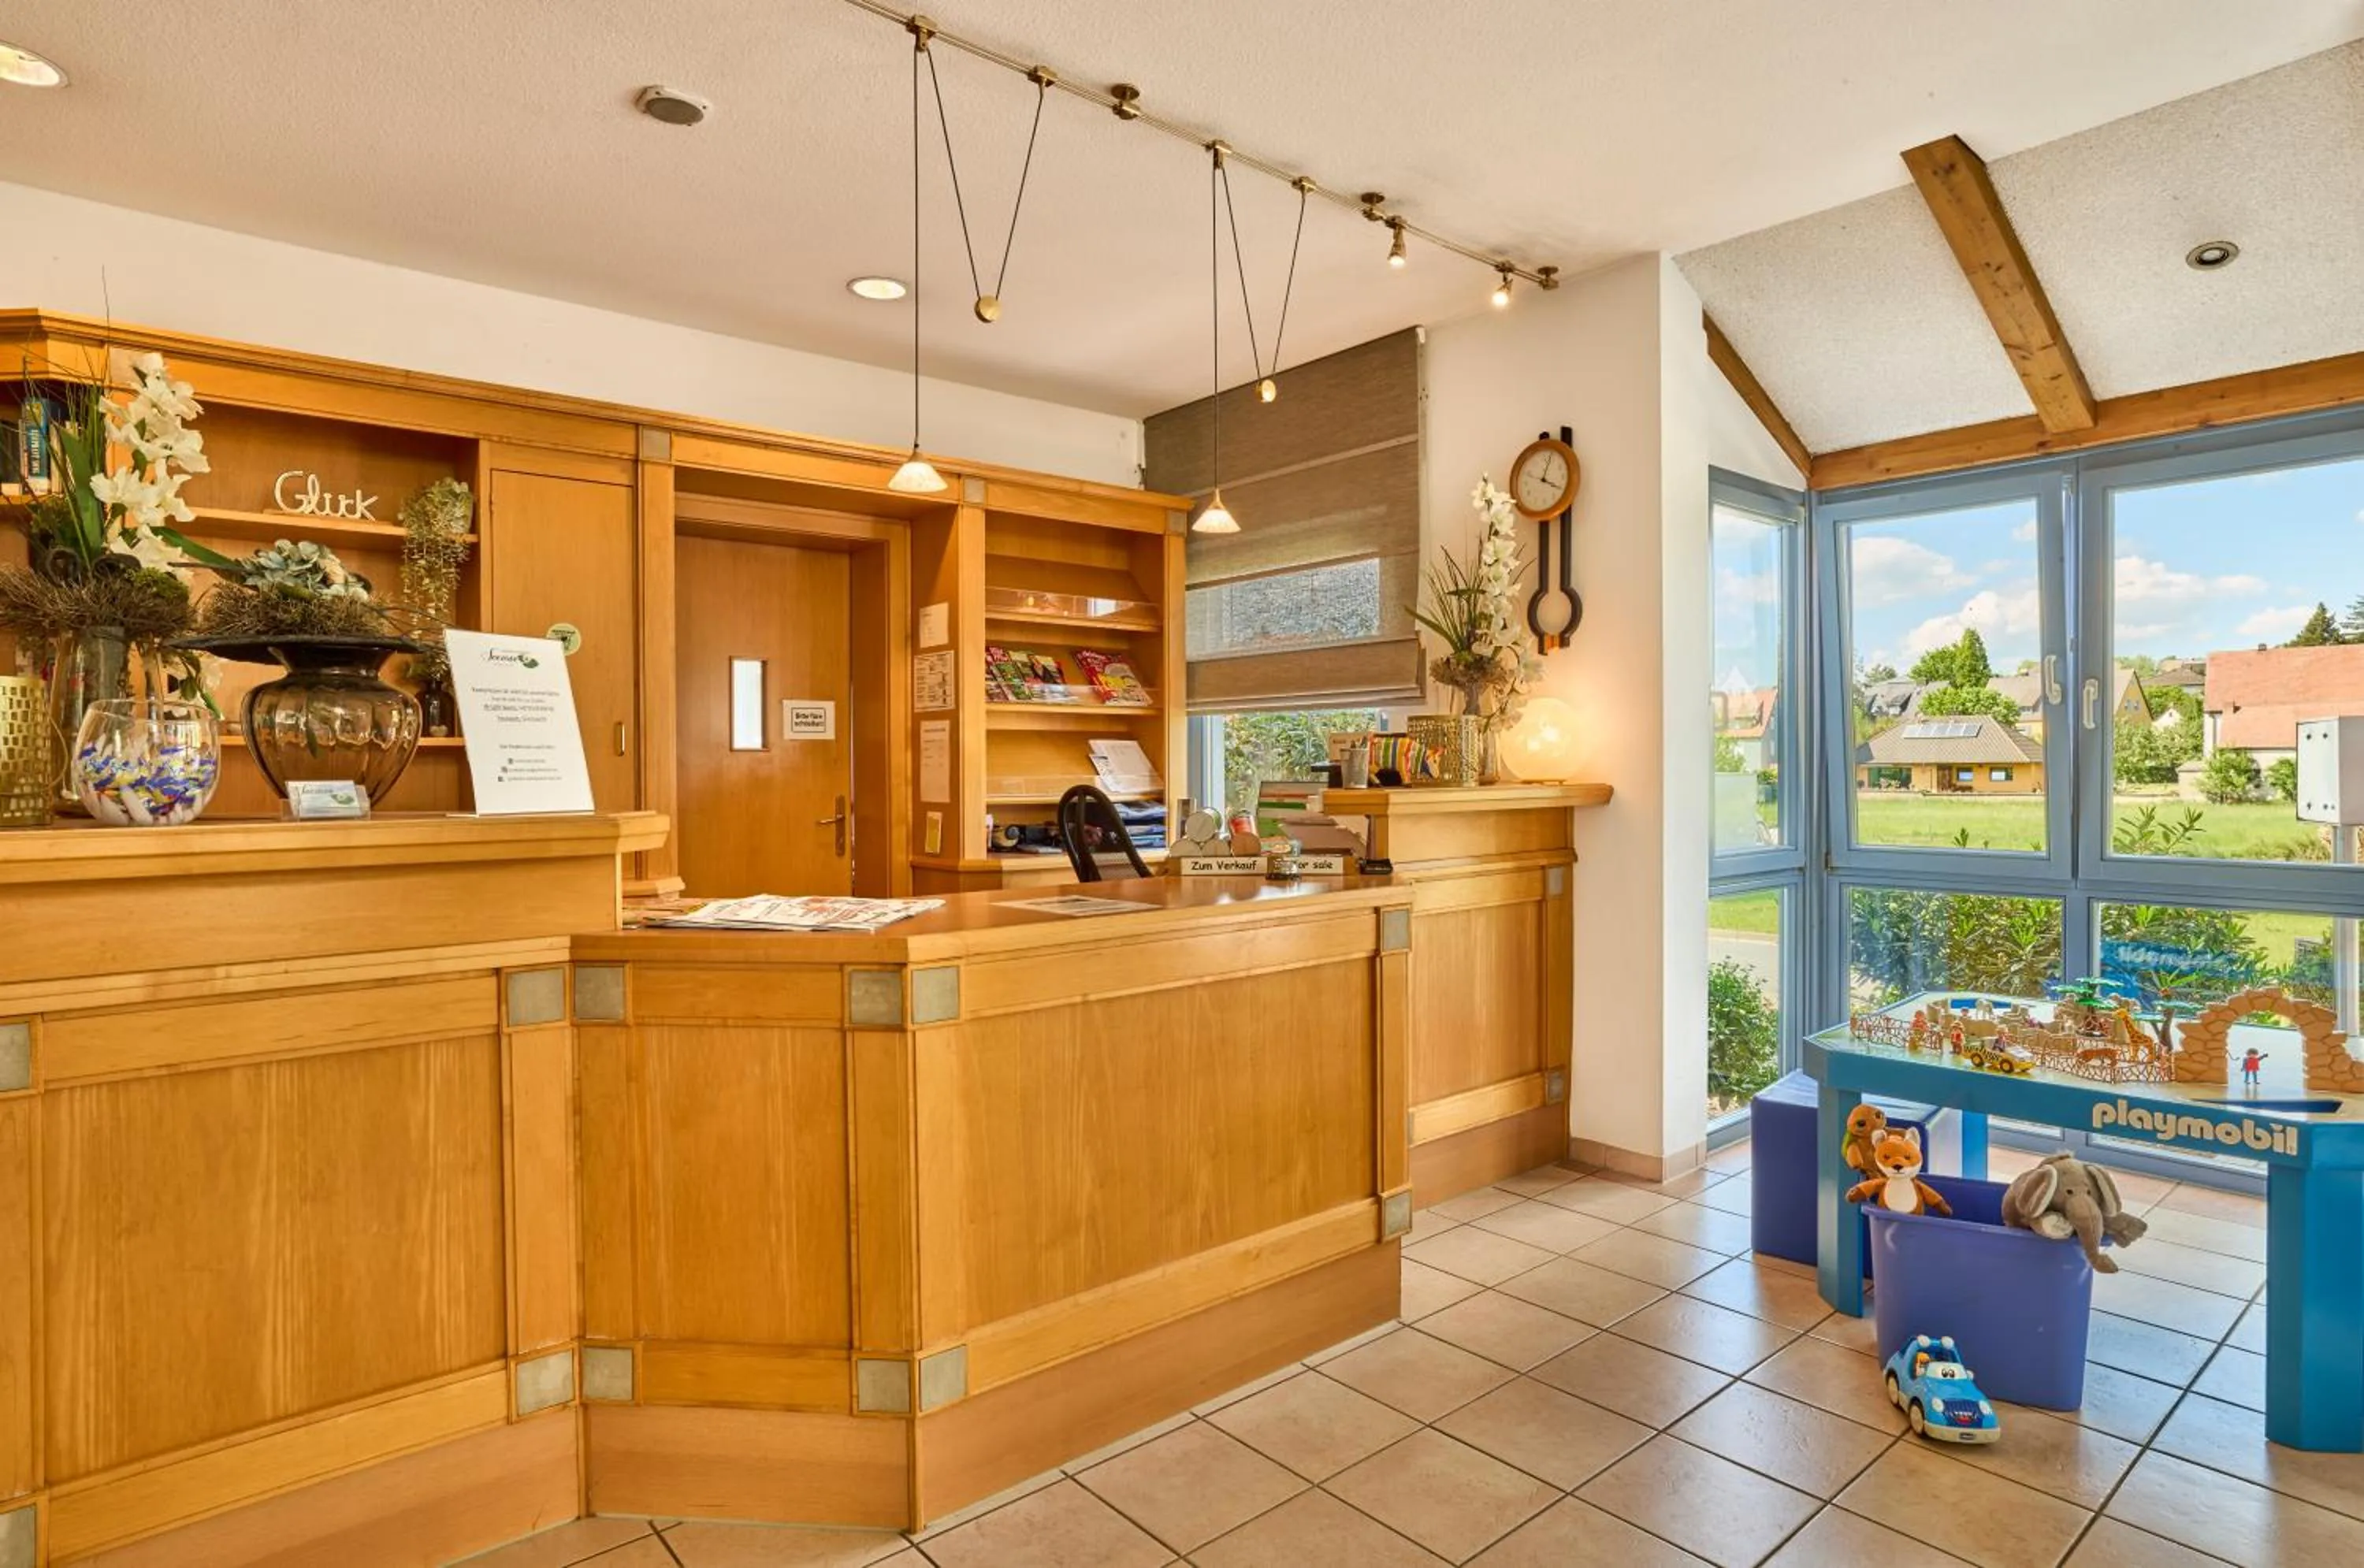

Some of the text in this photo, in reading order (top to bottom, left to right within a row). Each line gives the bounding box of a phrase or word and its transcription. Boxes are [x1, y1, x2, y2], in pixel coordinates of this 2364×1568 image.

[1191, 860, 1257, 871] Zum Verkauf
[1313, 860, 1333, 869] sale
[2092, 1098, 2298, 1156] playmobil
